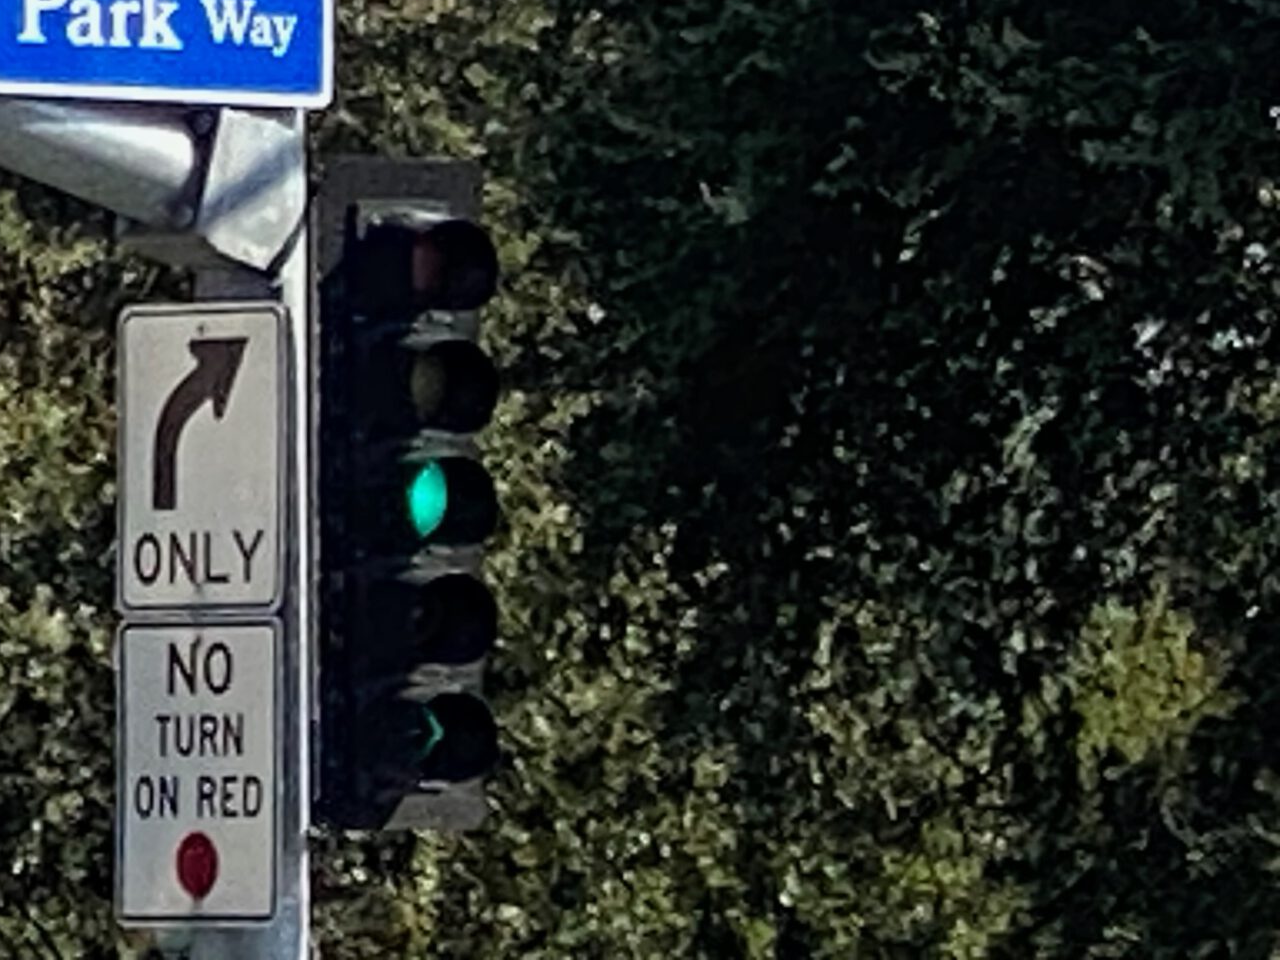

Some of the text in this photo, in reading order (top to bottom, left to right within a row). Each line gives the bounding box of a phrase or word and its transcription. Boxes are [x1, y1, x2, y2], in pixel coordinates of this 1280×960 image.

[134, 530, 264, 586] ONLY
[166, 642, 232, 696] NO
[155, 714, 244, 757] TURN
[134, 776, 262, 819] ON RED
